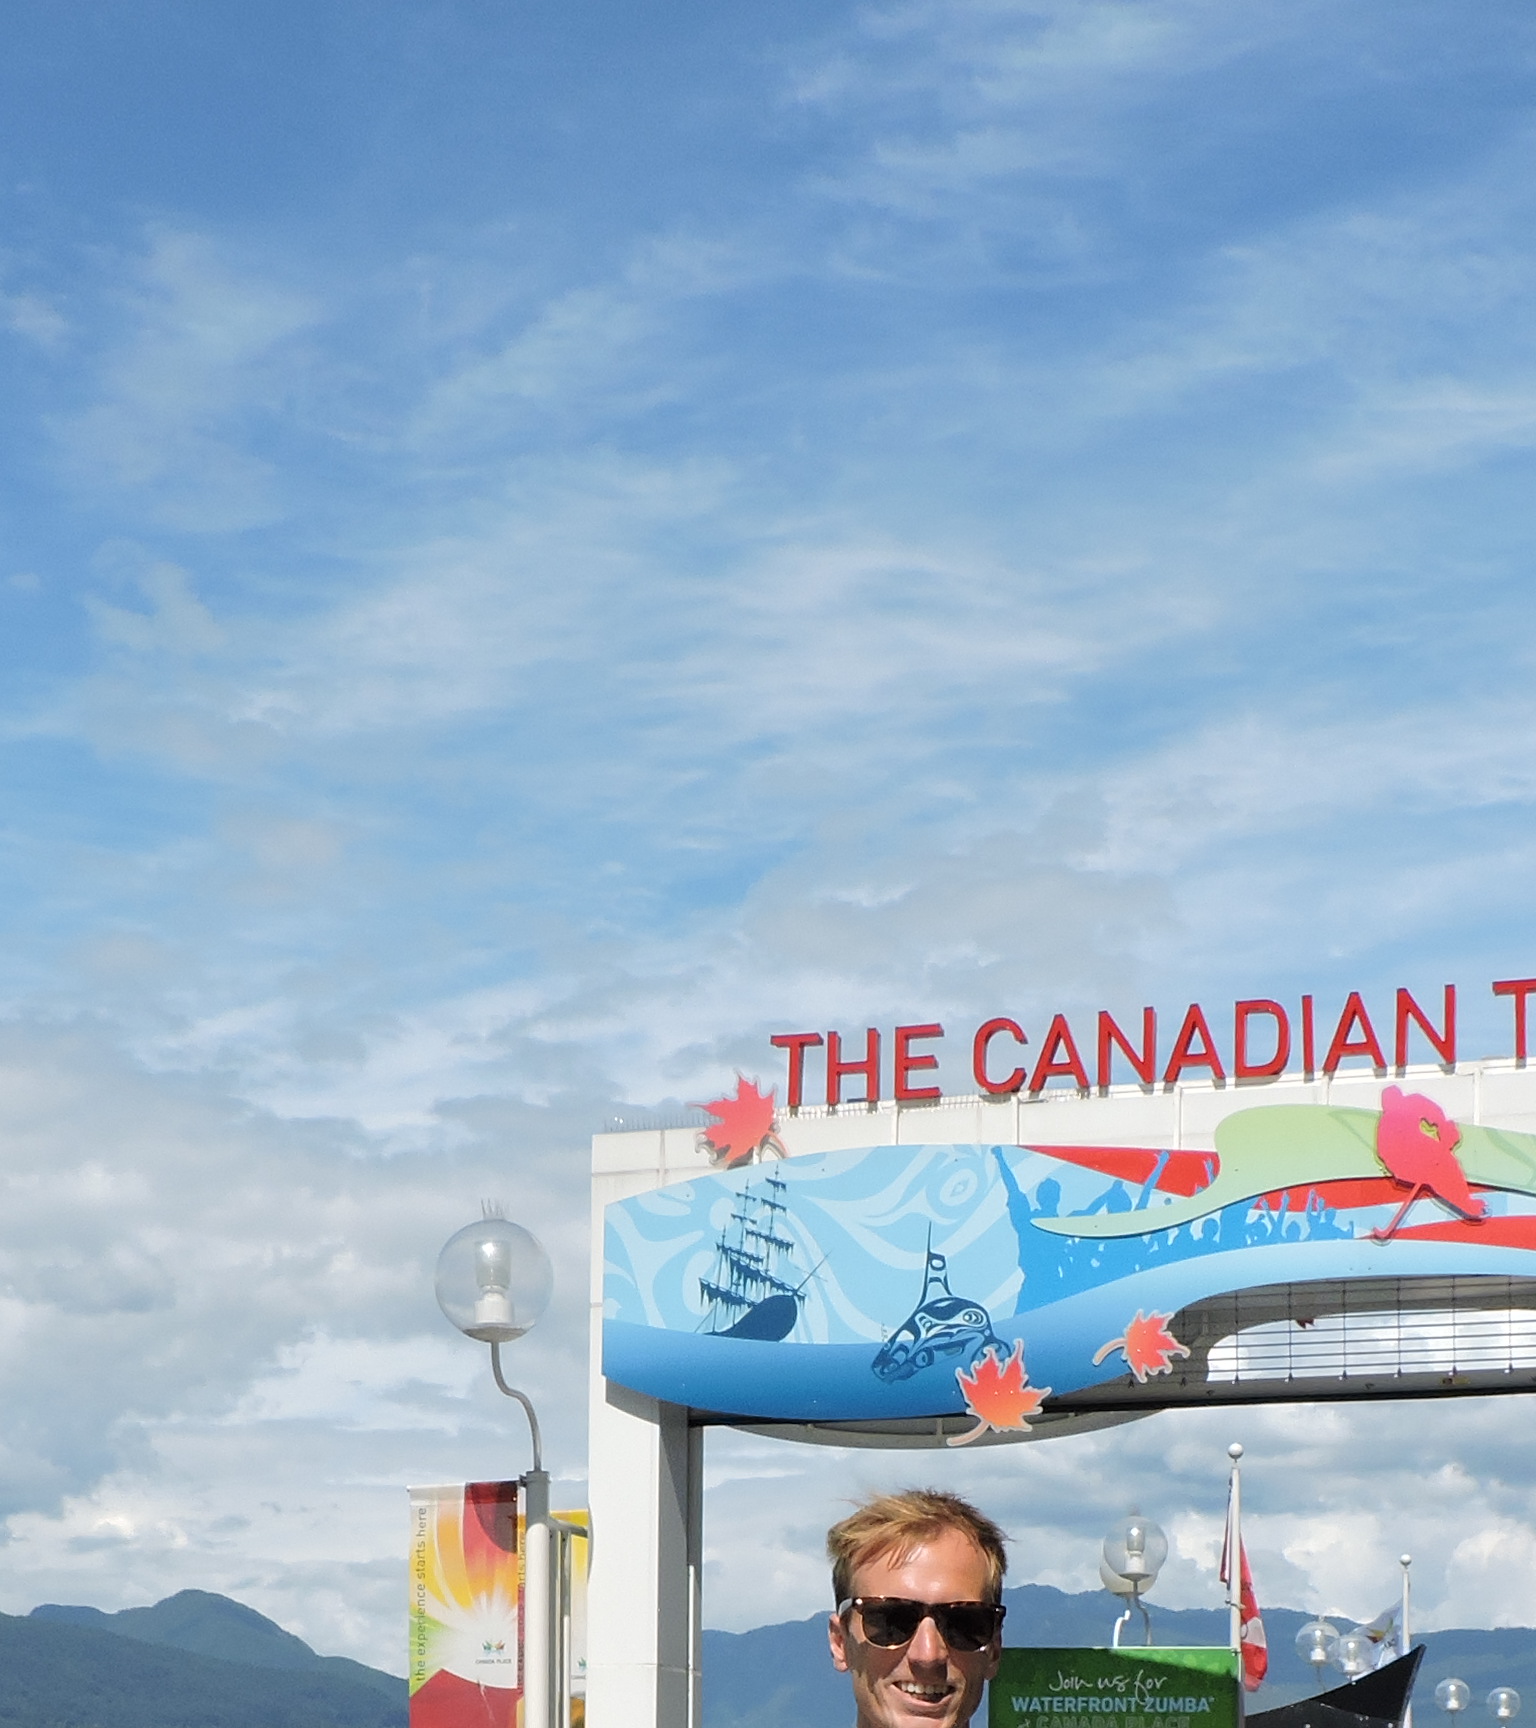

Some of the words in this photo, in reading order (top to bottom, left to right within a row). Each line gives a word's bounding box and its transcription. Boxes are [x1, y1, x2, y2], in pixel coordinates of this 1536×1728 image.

[770, 1022, 944, 1108] THE
[972, 983, 1457, 1095] CANADIAN
[416, 1508, 426, 1538] here
[416, 1541, 426, 1580] starts
[415, 1584, 428, 1655] experience
[415, 1661, 426, 1681] the
[1049, 1670, 1092, 1691] Join
[1098, 1676, 1130, 1692] us
[1134, 1669, 1168, 1705] for
[1011, 1696, 1138, 1713] WATERFRONT
